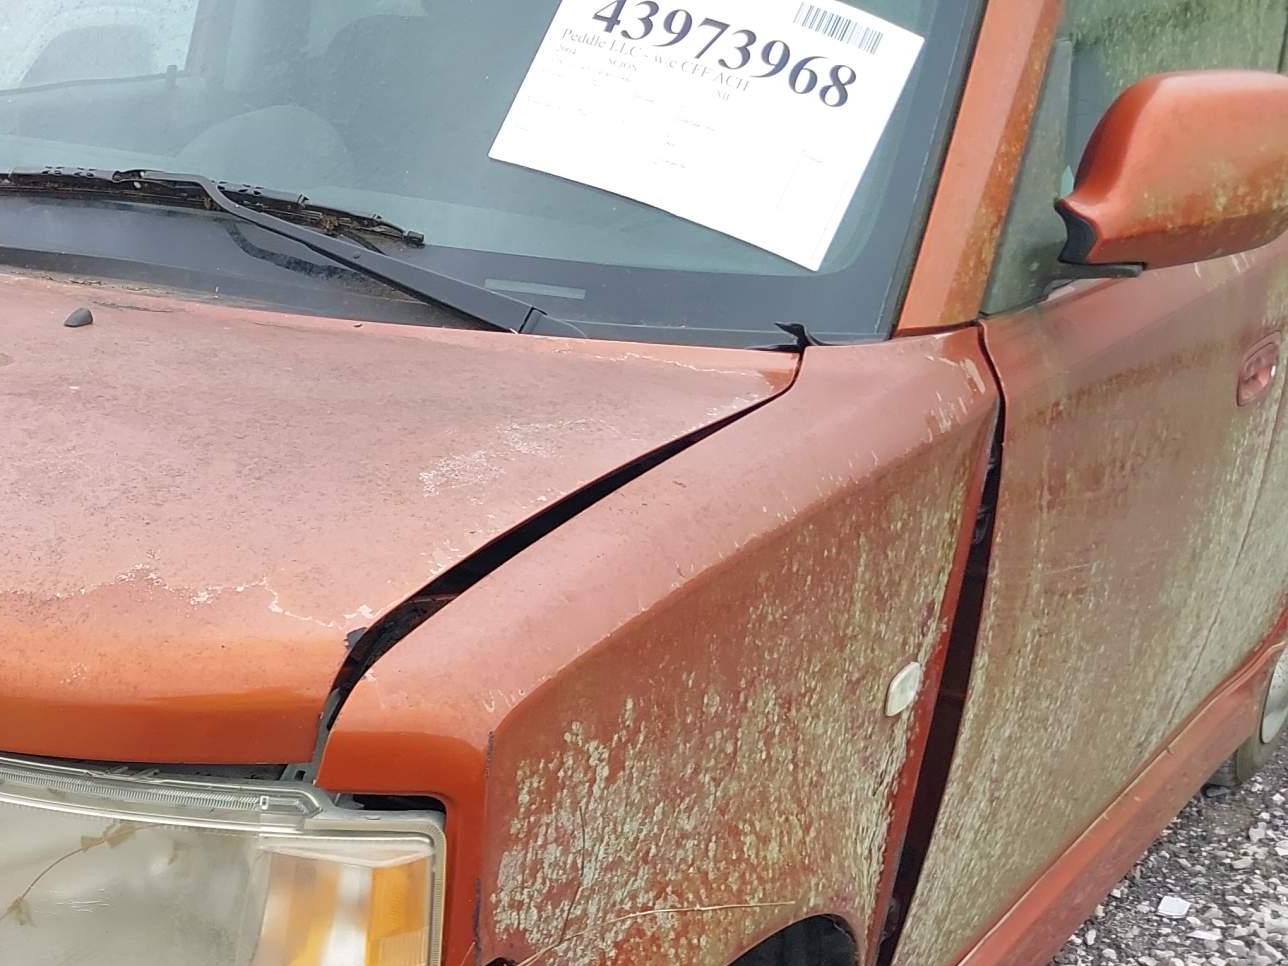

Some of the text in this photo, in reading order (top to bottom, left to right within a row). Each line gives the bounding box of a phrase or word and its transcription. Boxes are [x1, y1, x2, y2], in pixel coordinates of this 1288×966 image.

[561, 27, 607, 48] Peddle
[609, 39, 643, 57] LLC
[592, 0, 857, 107] 43973968
